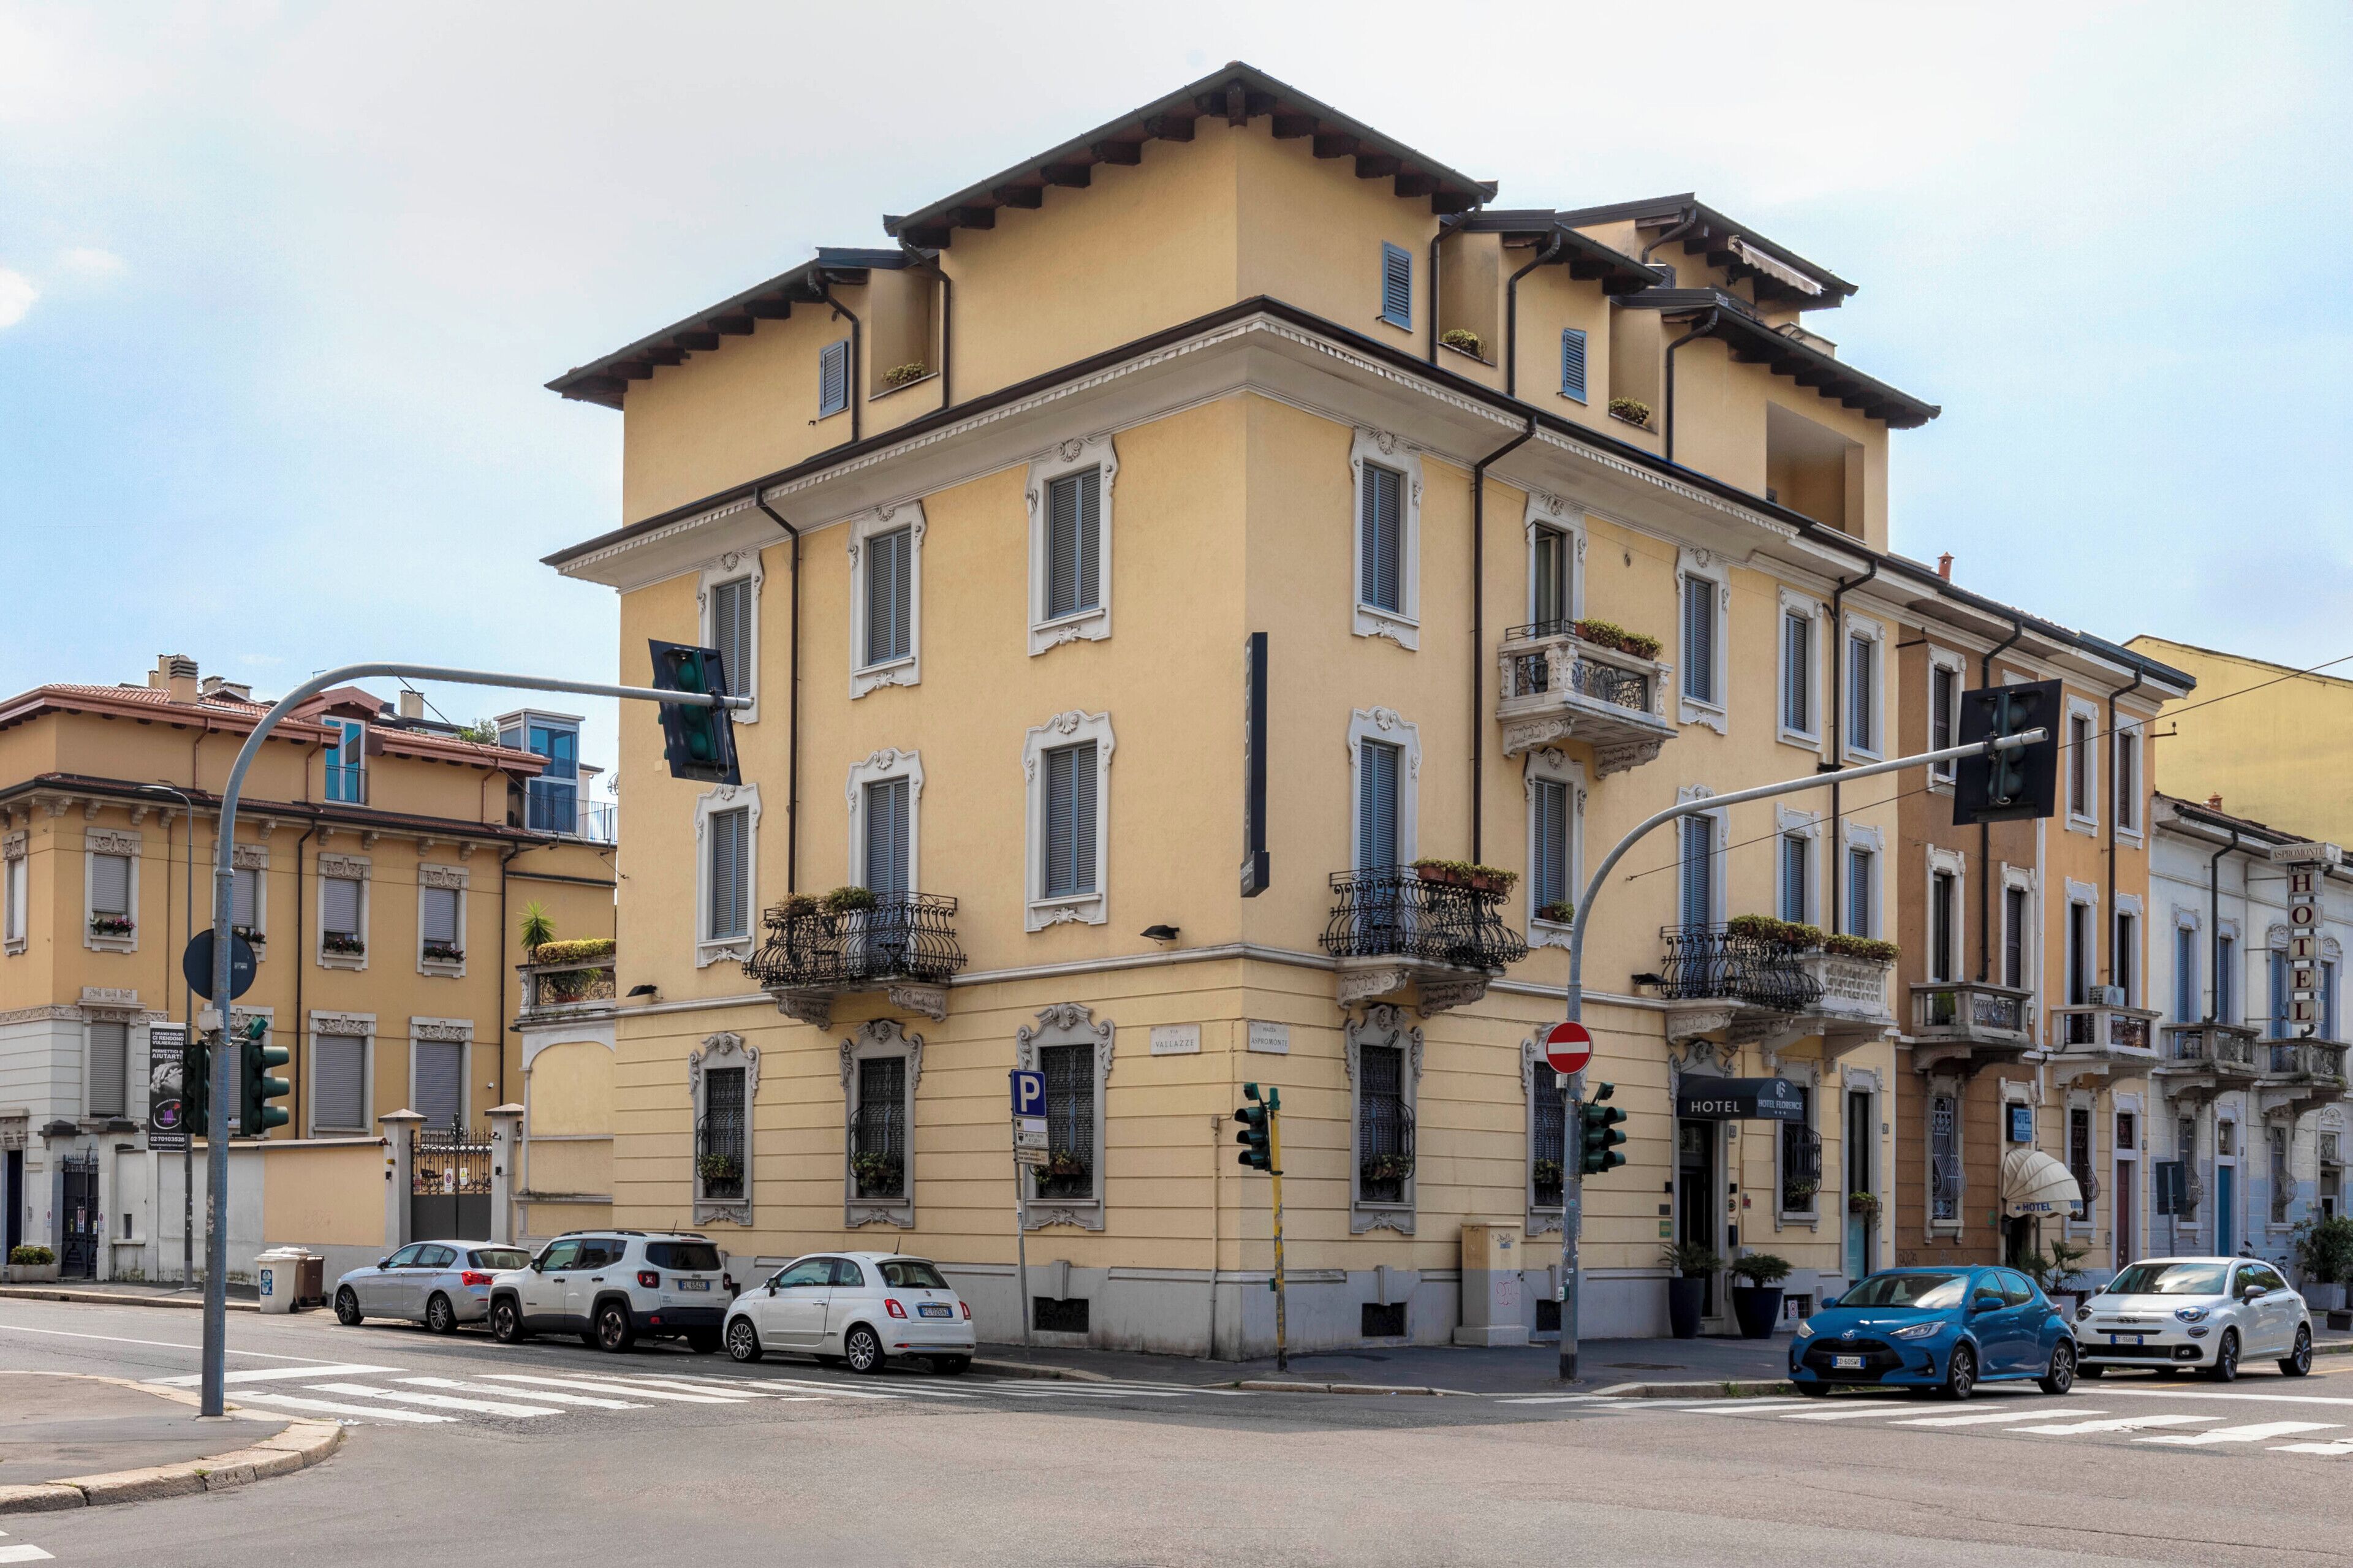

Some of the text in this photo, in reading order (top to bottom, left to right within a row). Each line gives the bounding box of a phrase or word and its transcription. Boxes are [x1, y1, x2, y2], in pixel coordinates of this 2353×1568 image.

[2274, 847, 2324, 858] ASPROMONTE
[2290, 874, 2312, 1021] HOTEL
[1155, 1039, 1194, 1048] VALLAZZE
[1251, 1037, 1288, 1047] ASPROMONTE
[1020, 1075, 1040, 1112] P
[1691, 1101, 1740, 1112] HOTEL
[1758, 1099, 1803, 1110] HOTEL FLORENCE
[2014, 1110, 2031, 1124] HOTEL
[2023, 1202, 2052, 1211] HOTEL
